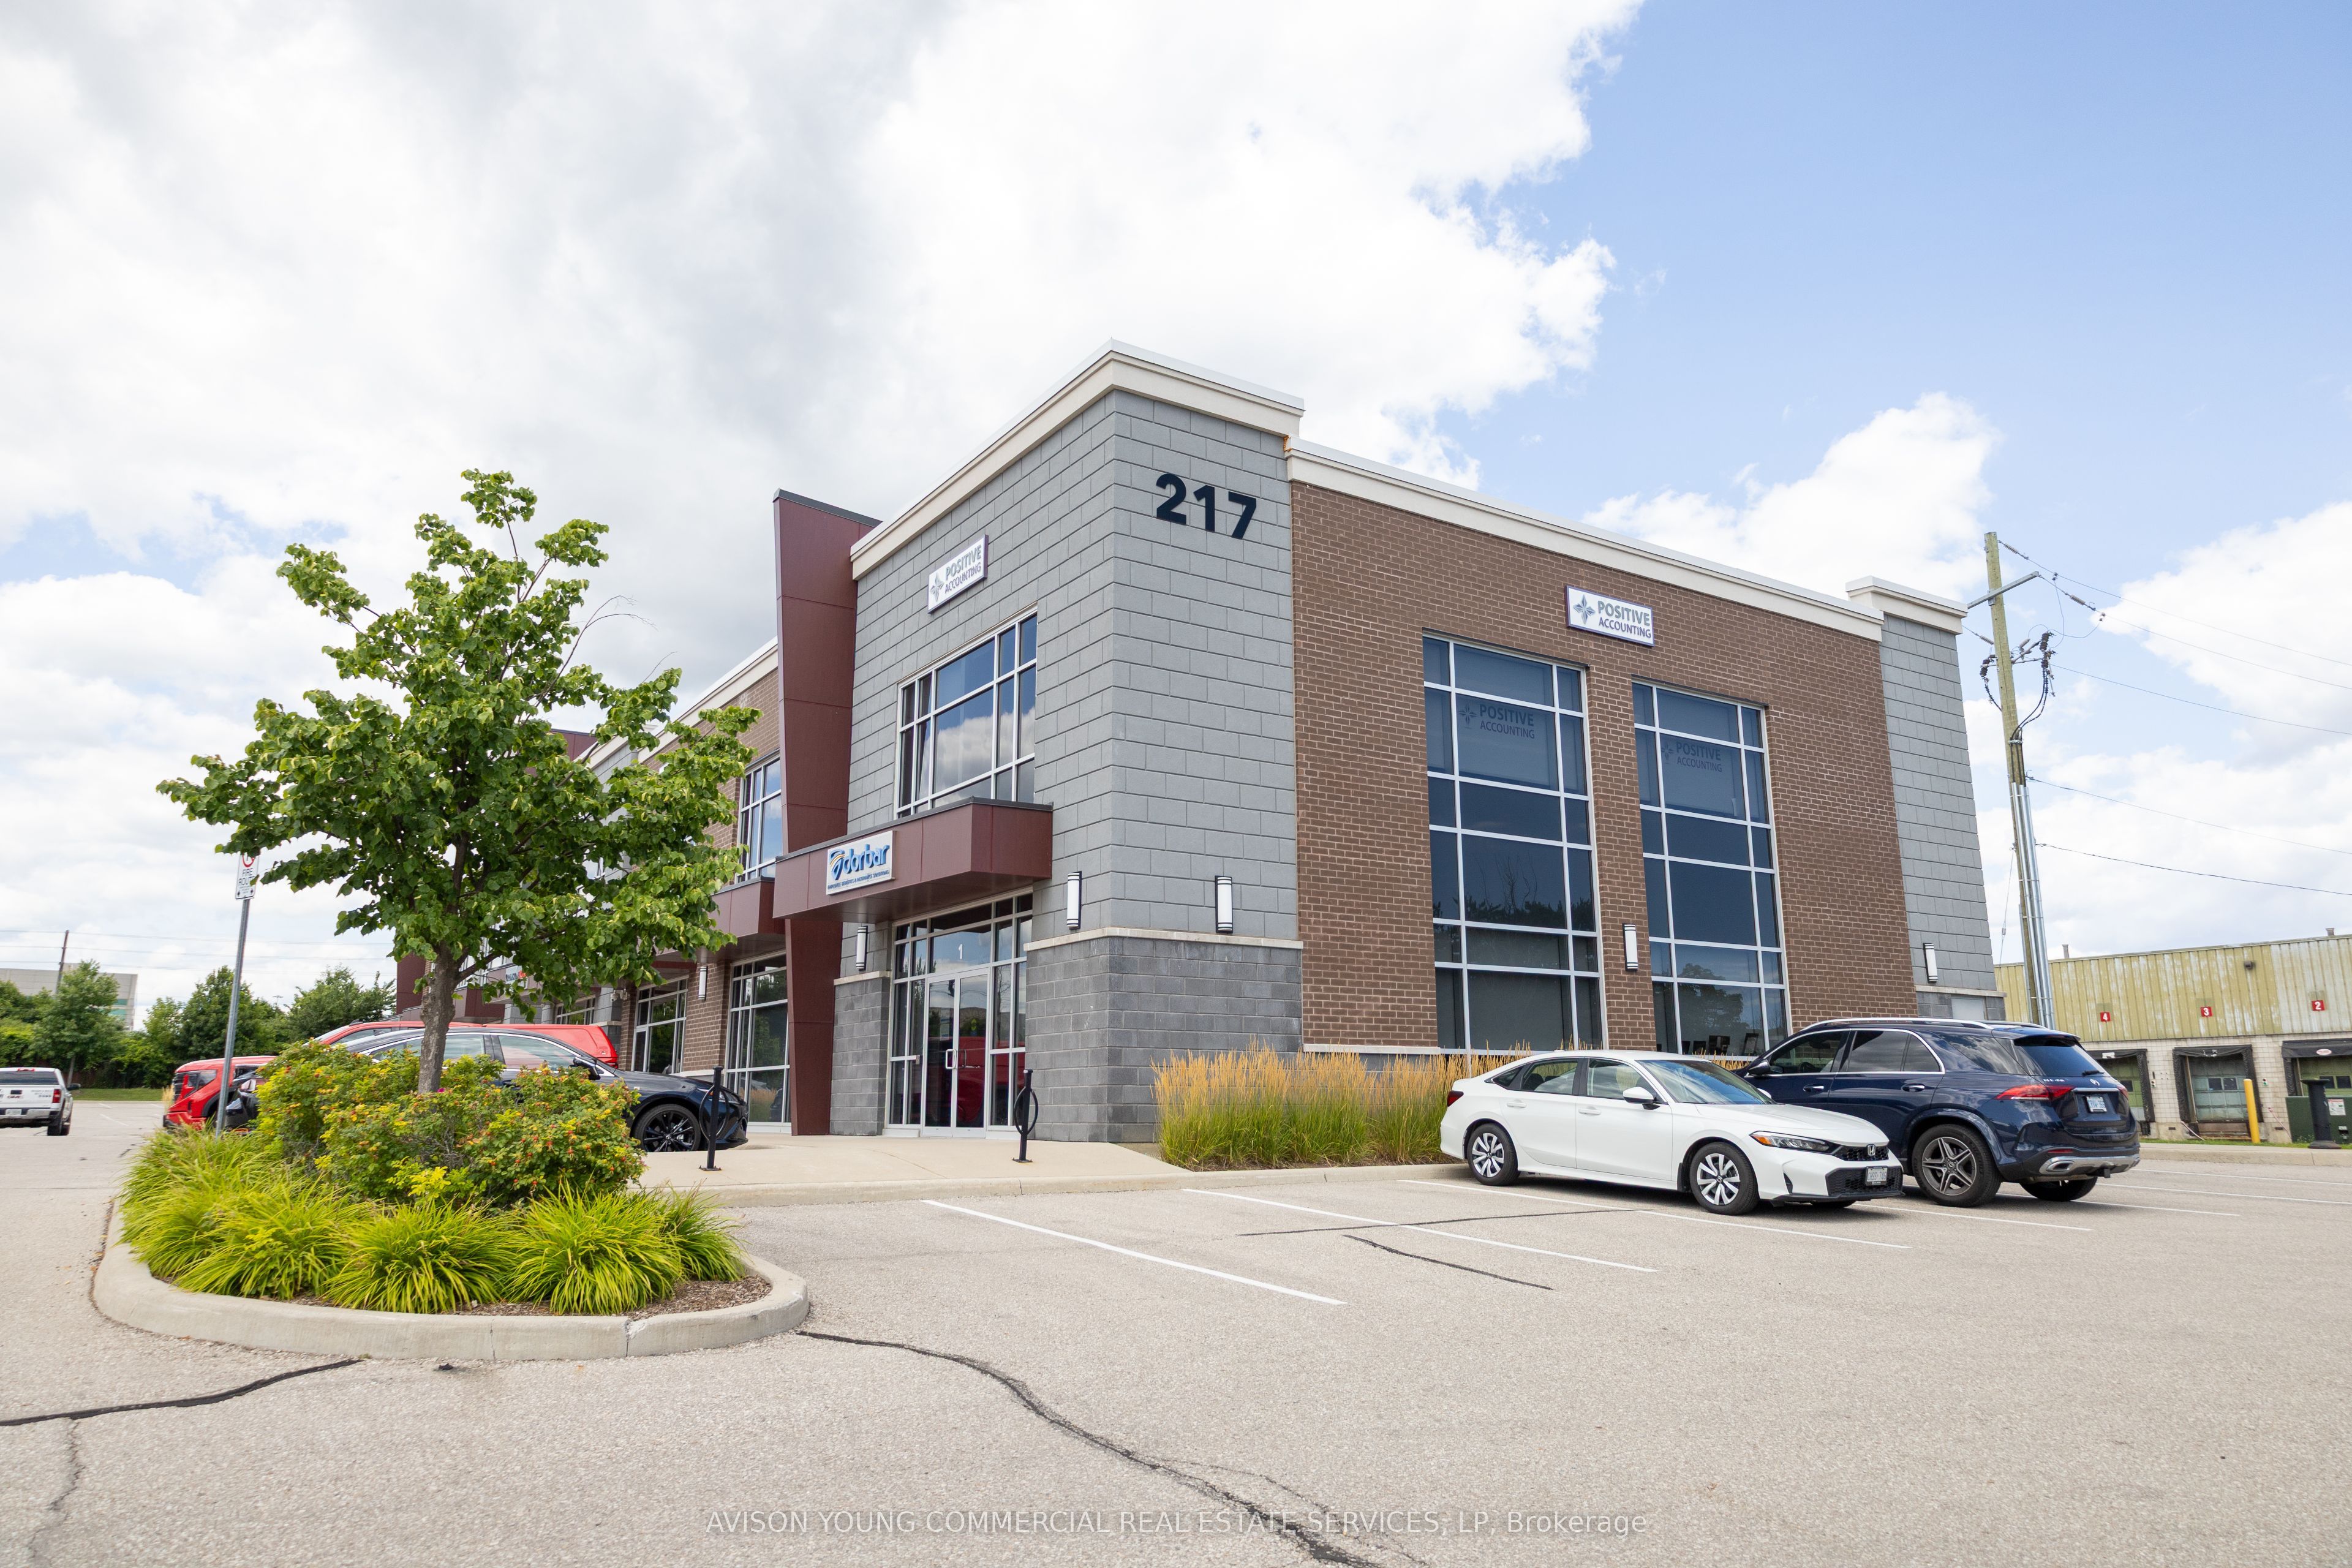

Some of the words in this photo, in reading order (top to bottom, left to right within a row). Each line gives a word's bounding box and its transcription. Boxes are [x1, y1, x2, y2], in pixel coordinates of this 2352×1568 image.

[1156, 473, 1257, 540] 217
[945, 544, 981, 581] POSITIVE
[944, 562, 981, 594] ACCOUNTING
[1597, 600, 1651, 626] POSITIVE
[1599, 617, 1651, 638] ACCOUNTING
[1479, 703, 1534, 726] POSITIVE
[1480, 720, 1535, 739] ACCOUNTING
[1676, 741, 1721, 761] POSITIVE
[1677, 756, 1722, 772] ACCOUNTING
[843, 843, 890, 874] dorbar
[242, 867, 254, 877] FIRE
[958, 943, 963, 960] 1
[2203, 1008, 2209, 1016] 3
[2315, 1001, 2321, 1010] 2
